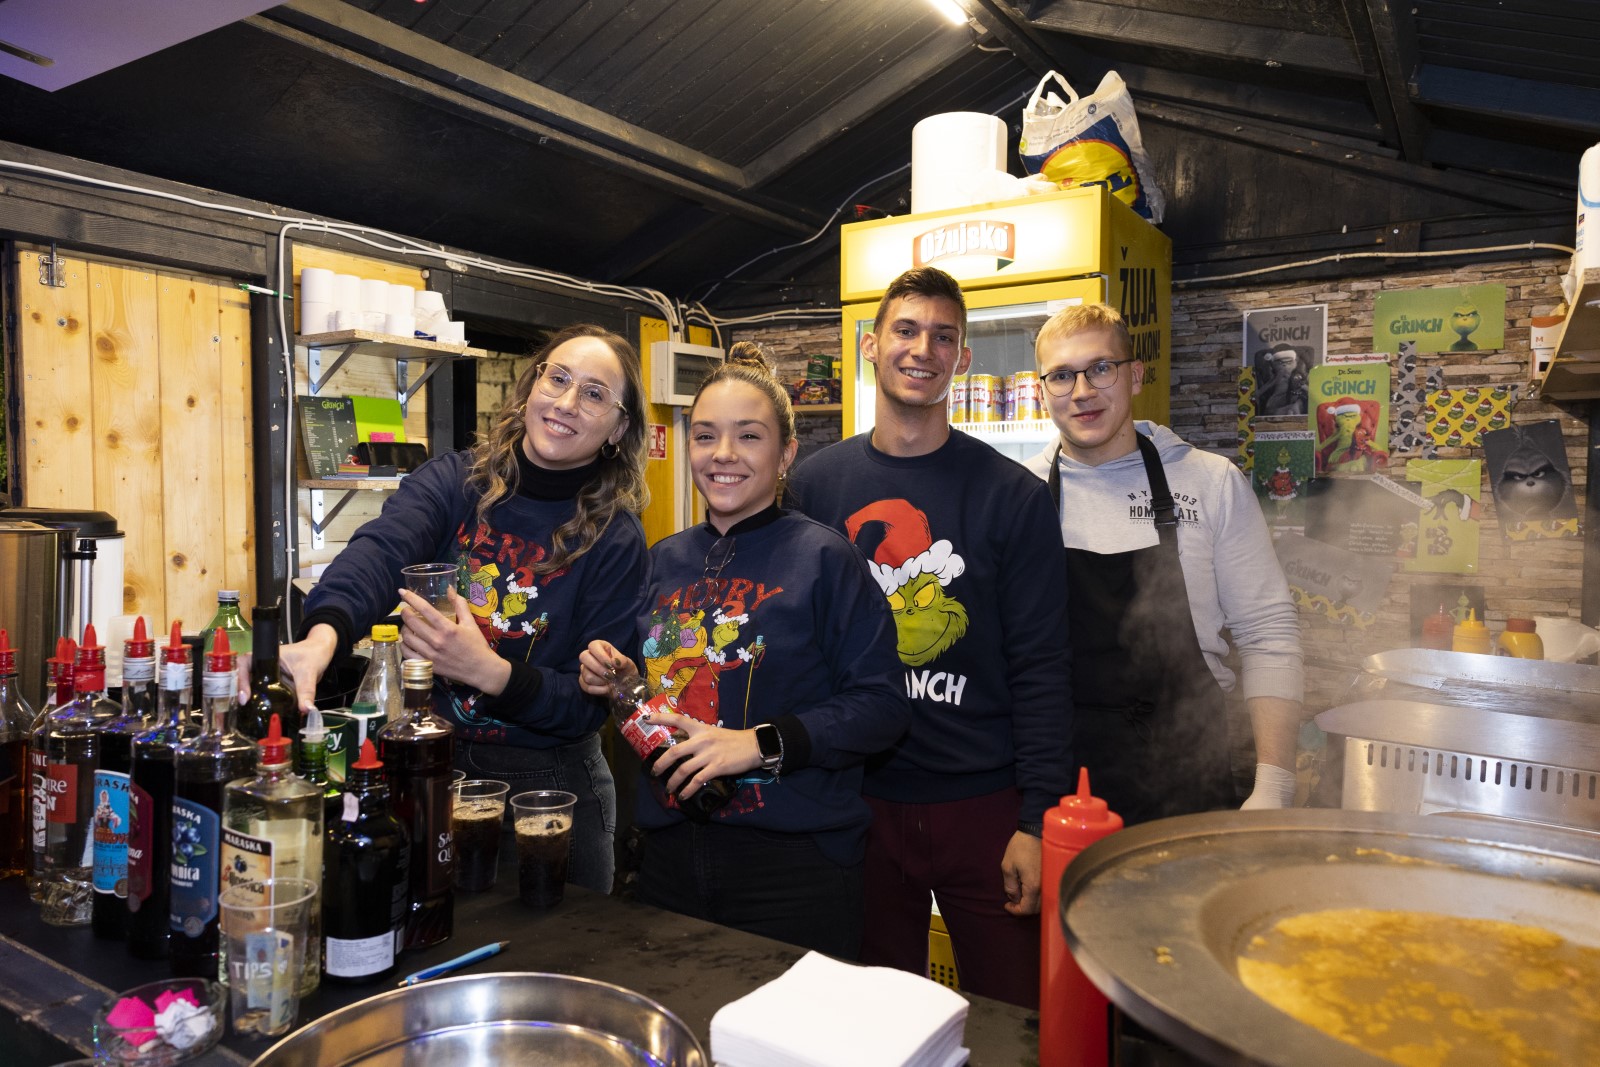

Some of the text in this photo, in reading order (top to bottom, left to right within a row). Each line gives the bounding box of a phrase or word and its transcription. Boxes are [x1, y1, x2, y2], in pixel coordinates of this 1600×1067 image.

[920, 221, 1009, 264] Ožujsko
[1258, 325, 1311, 343] GRINCH
[1389, 317, 1444, 335] GRINCH
[1321, 379, 1376, 396] GRINCH
[321, 399, 345, 410] GRINCH
[224, 833, 263, 853] MARASKA
[231, 961, 272, 981] TIPS
